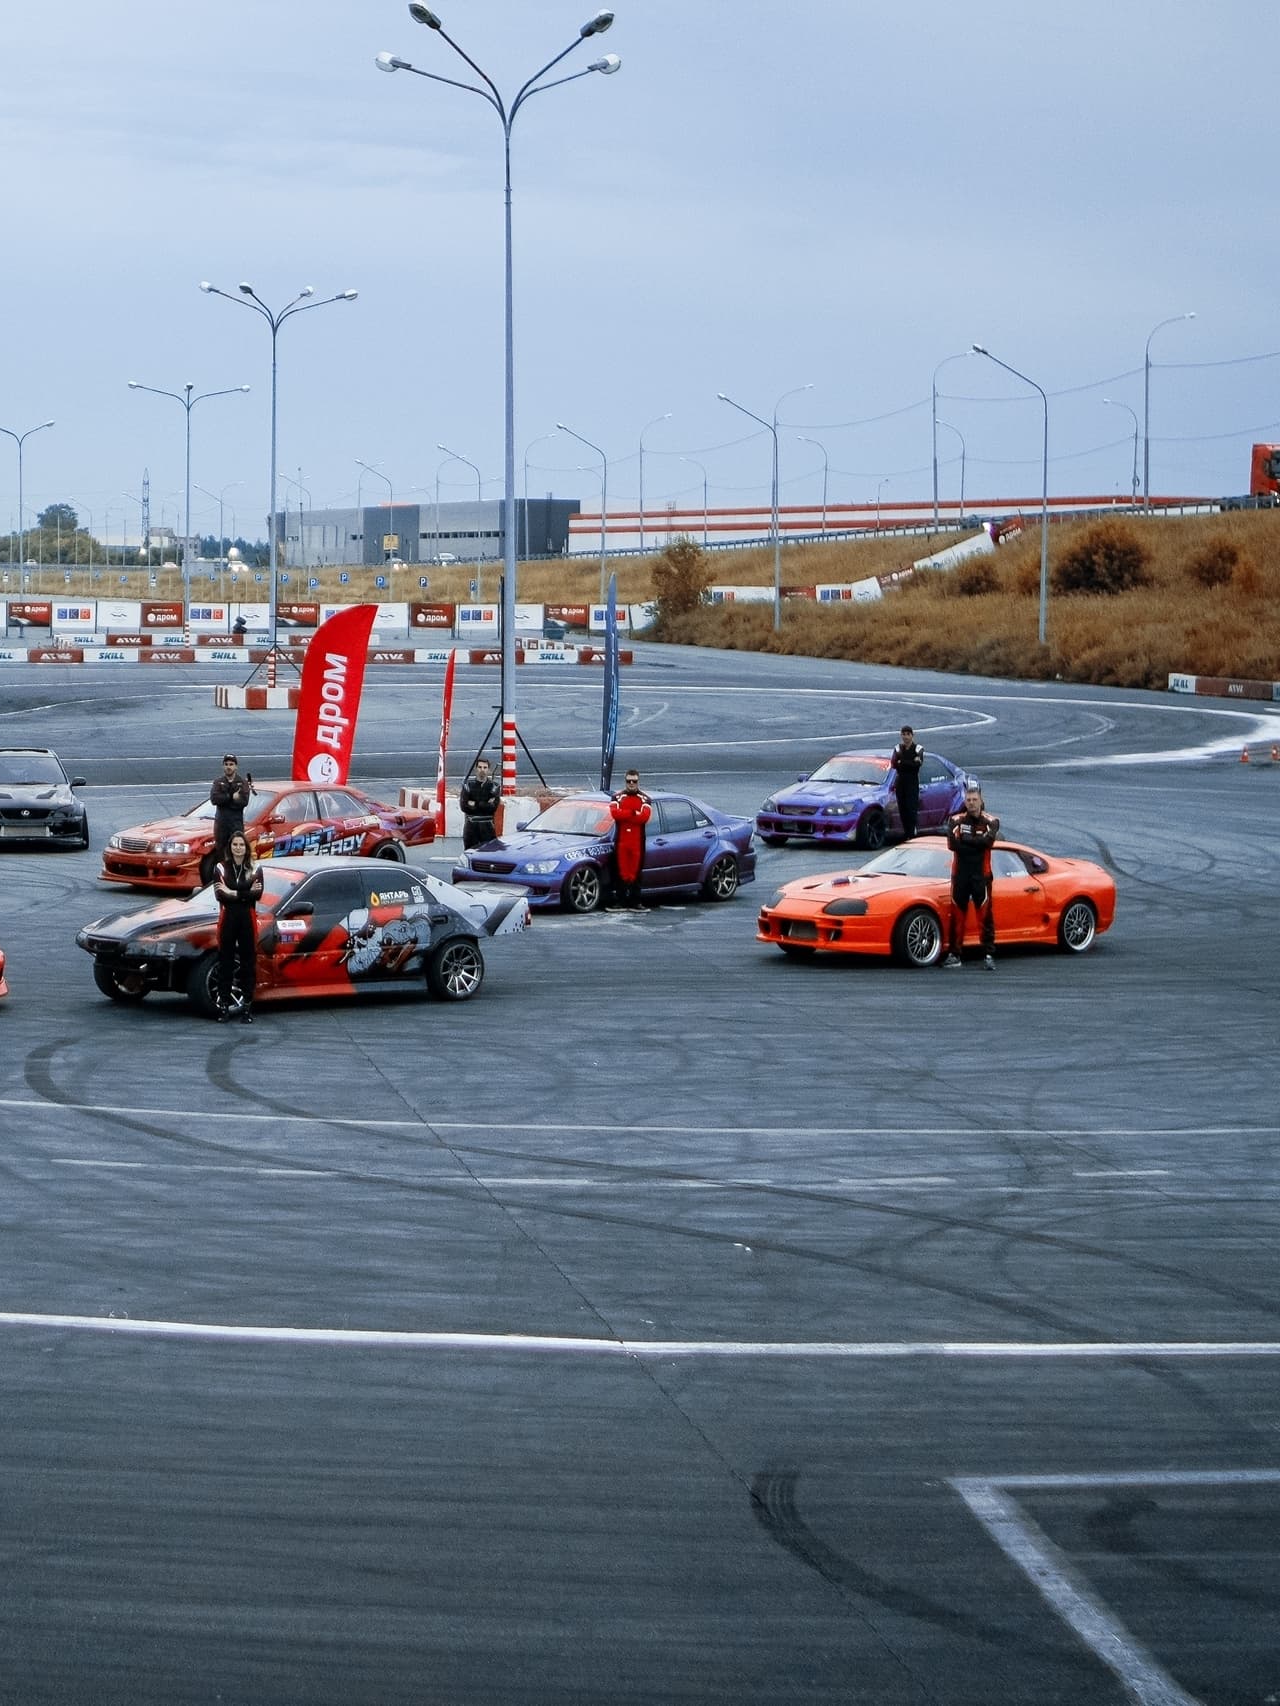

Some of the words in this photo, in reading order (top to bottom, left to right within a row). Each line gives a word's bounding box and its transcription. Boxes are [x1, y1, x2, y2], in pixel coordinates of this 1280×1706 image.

[57, 609, 90, 619] SKR
[190, 609, 223, 619] SKR
[461, 610, 493, 620] SKR
[99, 652, 124, 660] SKILL
[211, 652, 237, 660] SKILL
[316, 653, 349, 749] дром
[379, 890, 409, 900] ЯНТАРЬ
